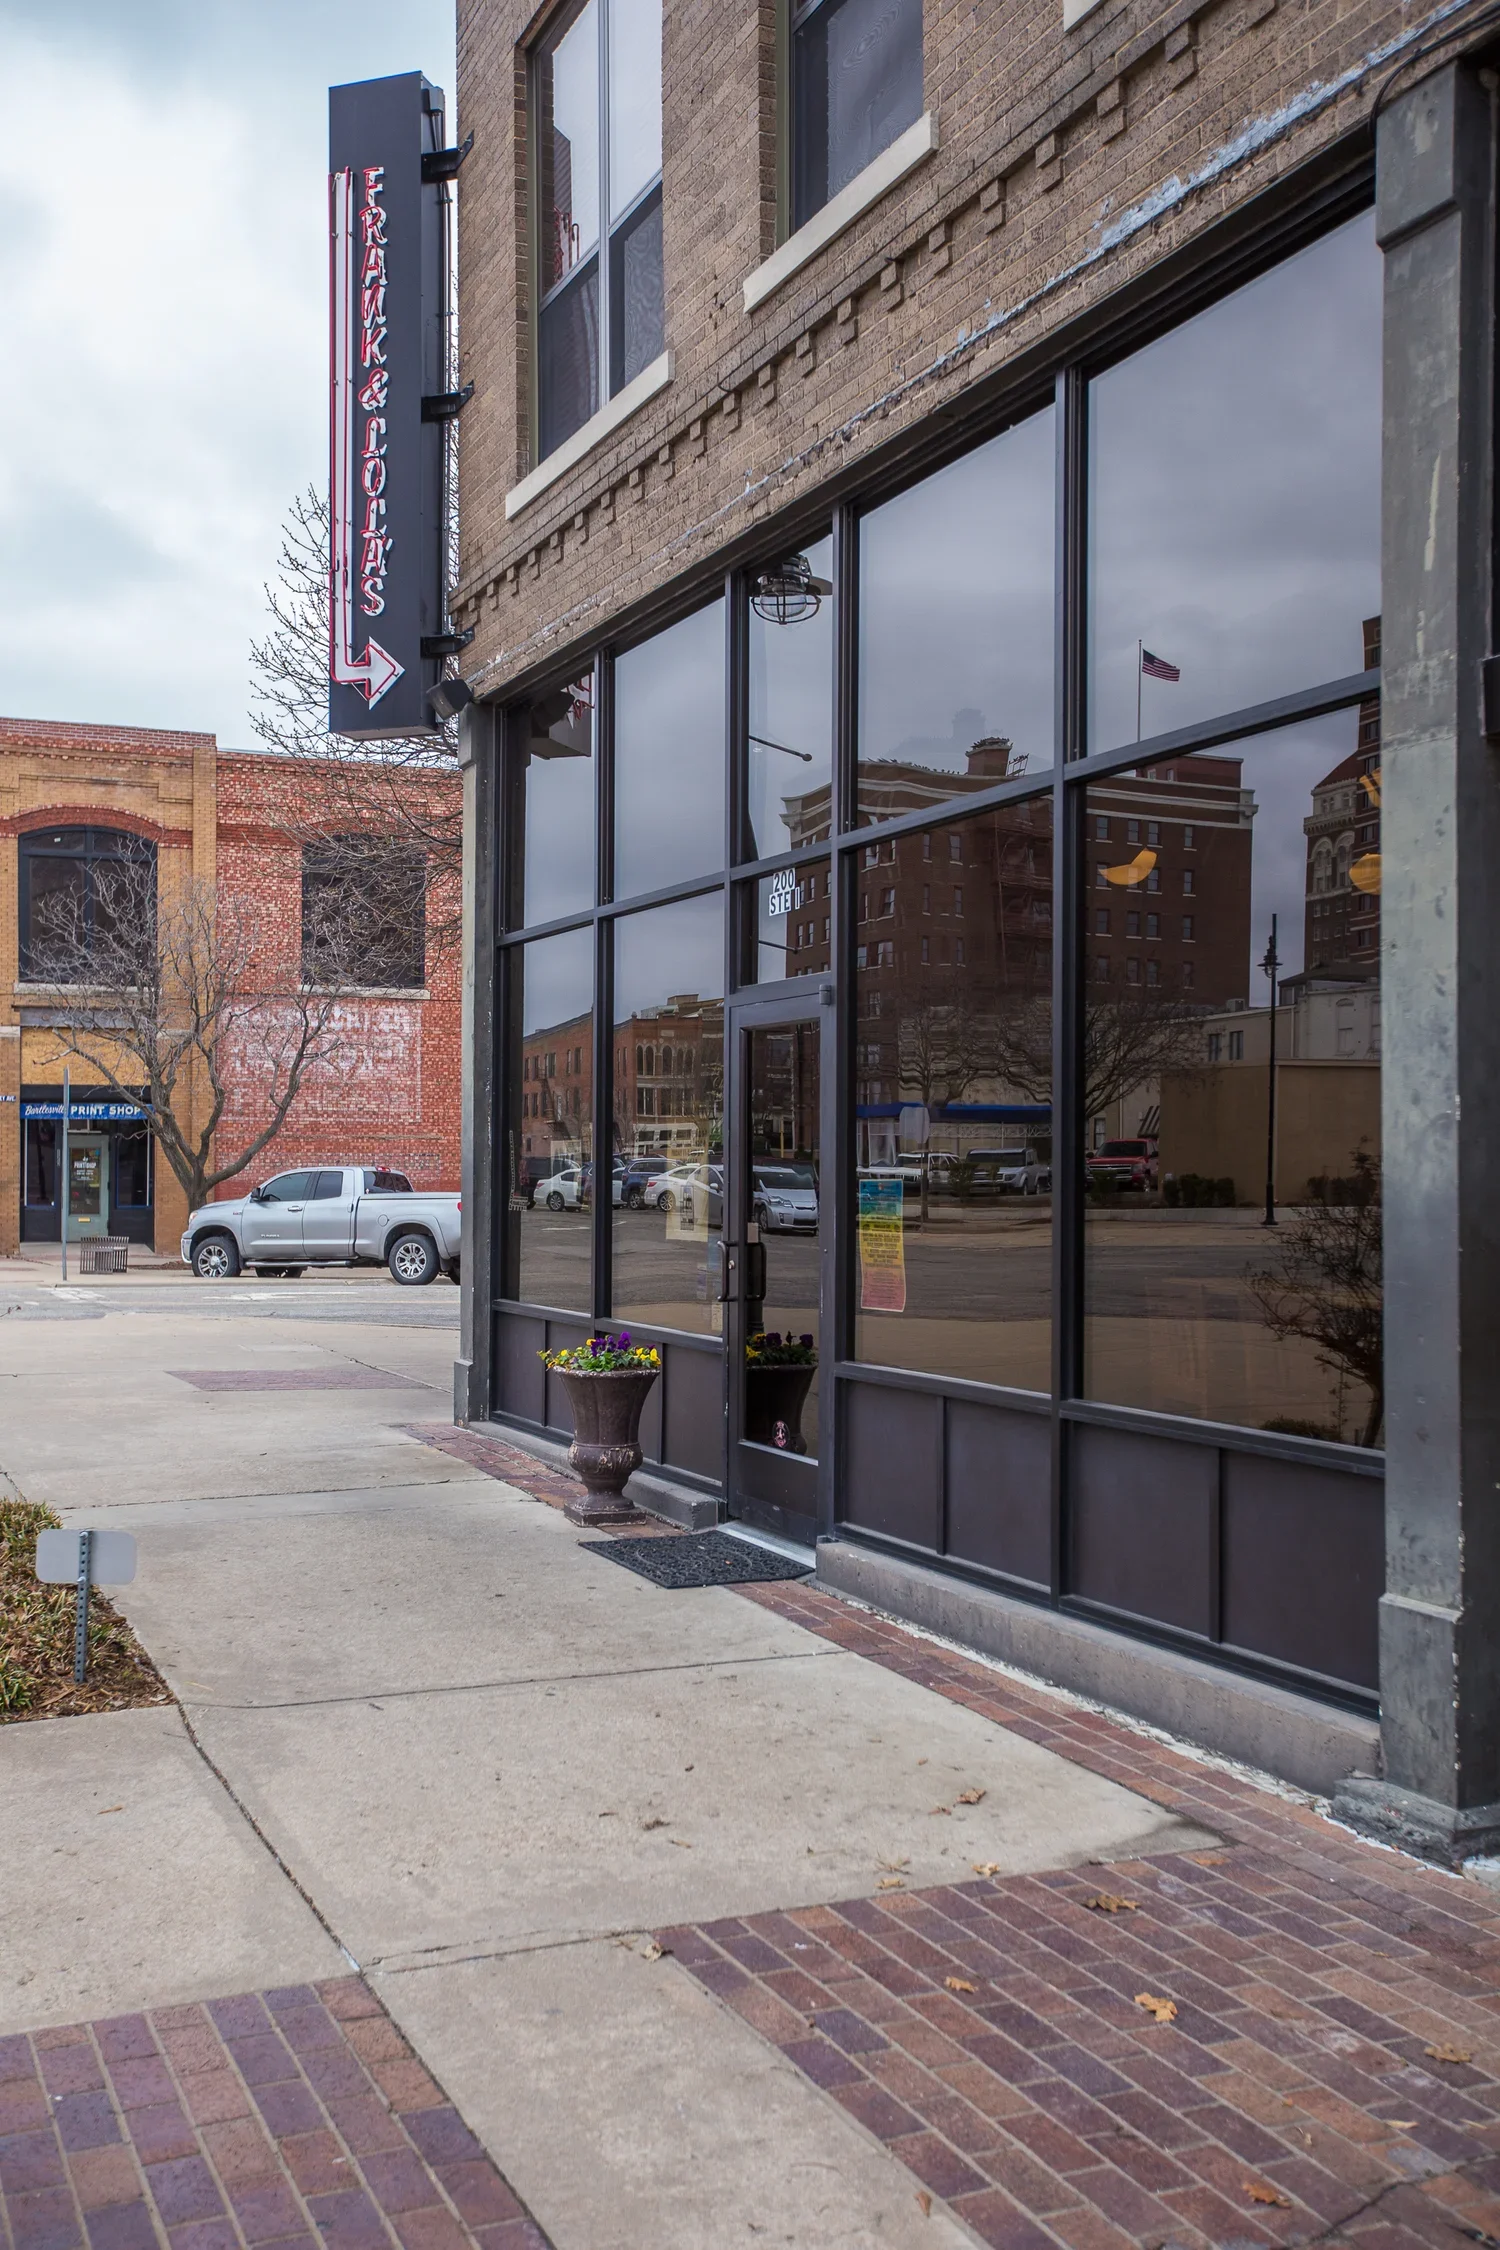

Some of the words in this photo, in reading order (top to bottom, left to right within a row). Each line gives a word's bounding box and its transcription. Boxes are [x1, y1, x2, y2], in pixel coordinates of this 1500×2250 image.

[359, 166, 388, 368] FRANK
[358, 368, 389, 411] &
[360, 416, 393, 617] LOLA'S
[774, 869, 795, 893] 200
[770, 890, 790, 914] STE
[71, 1105, 105, 1115] PRINT
[109, 1105, 141, 1115] SHOP
